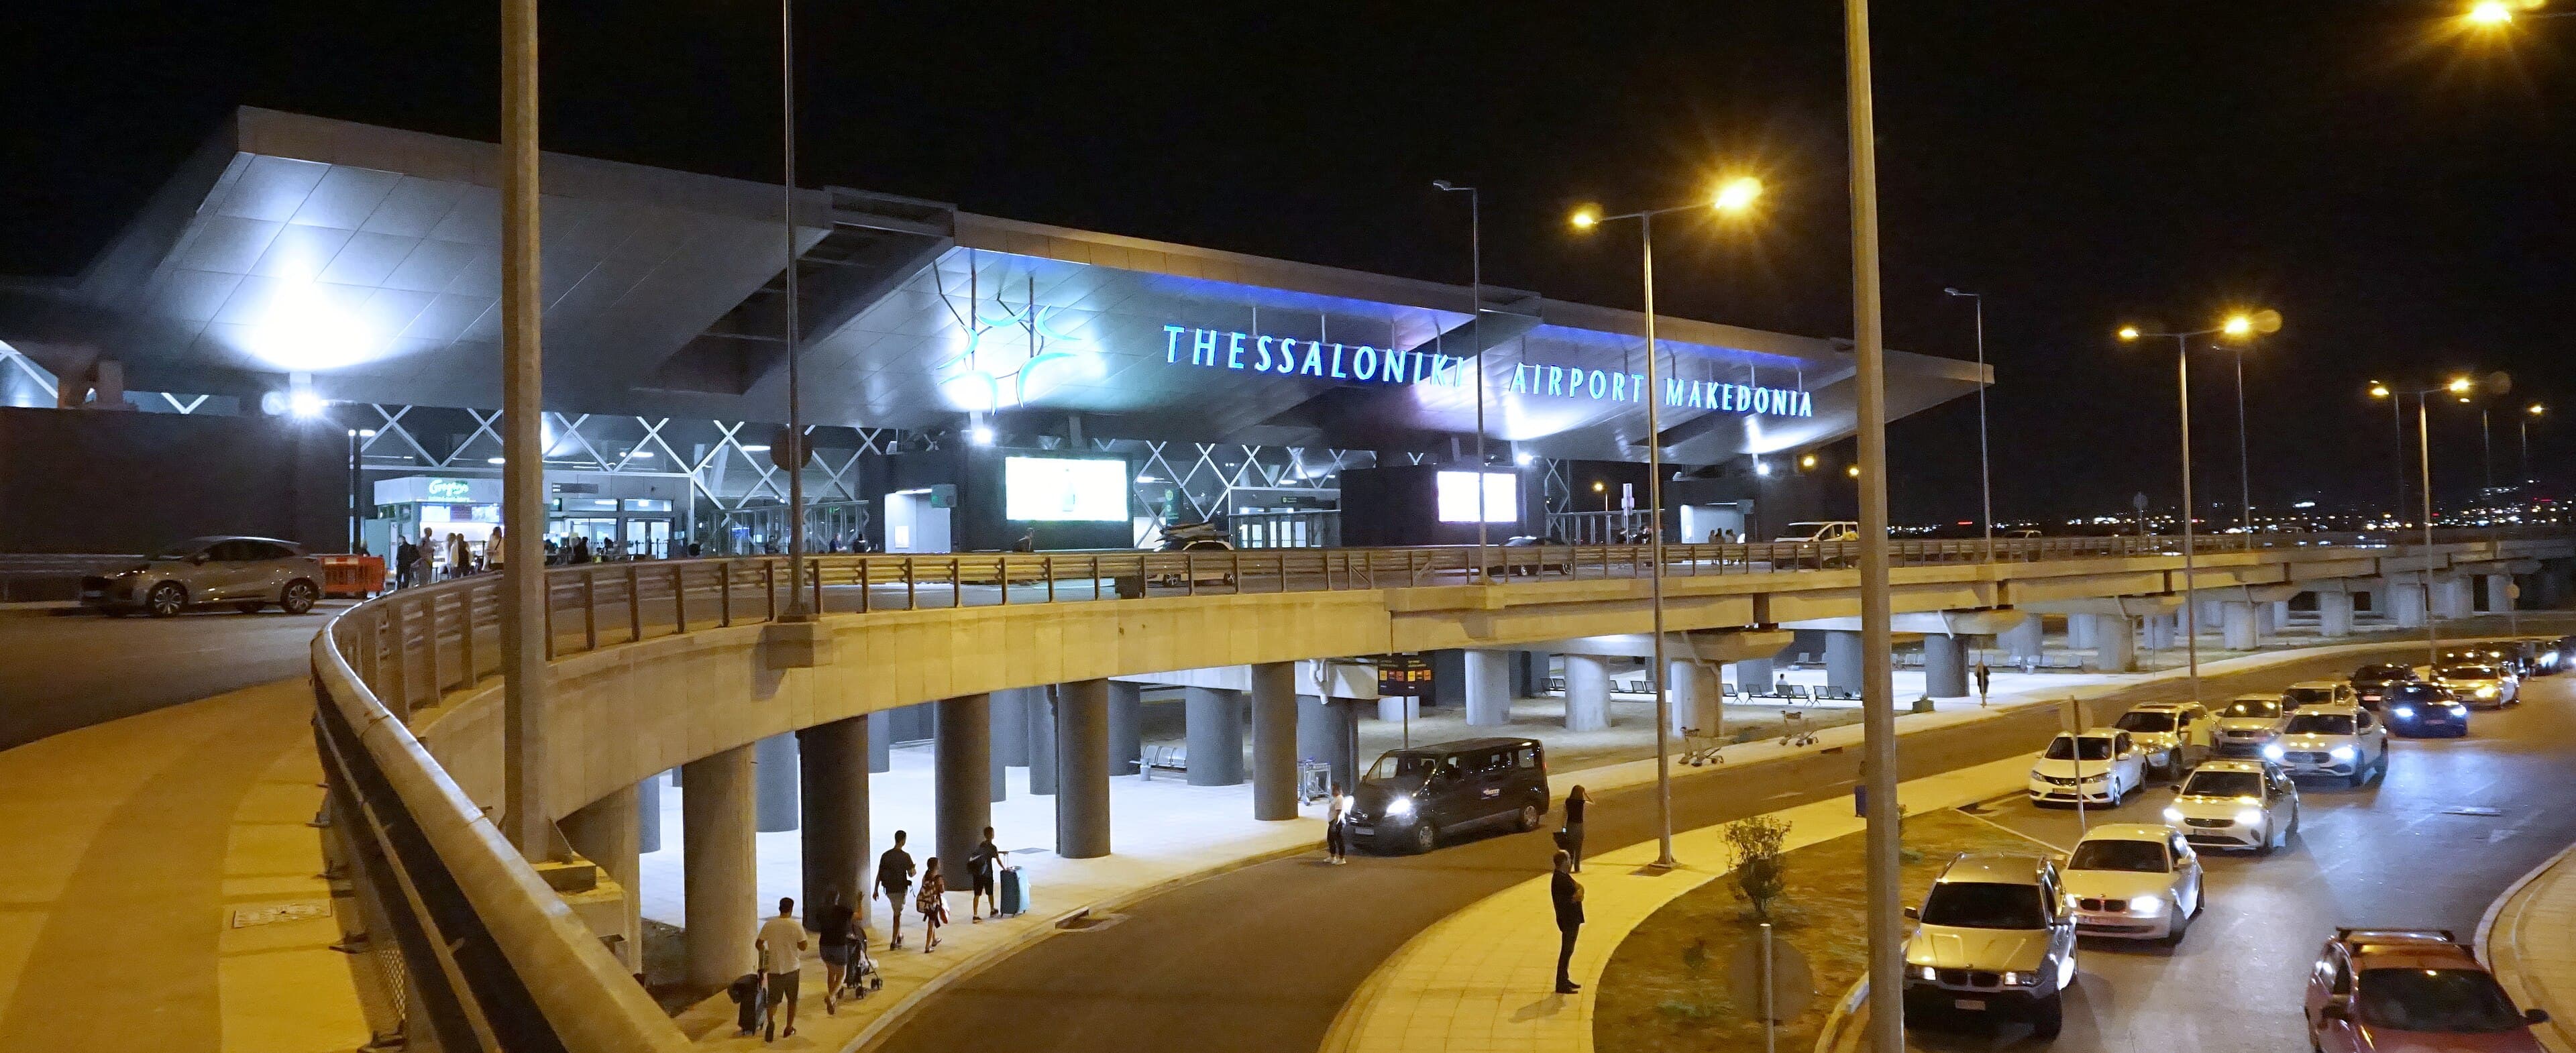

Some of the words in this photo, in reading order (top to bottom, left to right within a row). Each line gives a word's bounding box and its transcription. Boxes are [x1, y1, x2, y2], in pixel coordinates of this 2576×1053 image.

[1163, 325, 1464, 387] THESSALONIKI
[1509, 362, 1644, 402] AIRPORT
[1665, 378, 1813, 417] MAKEDONIA
